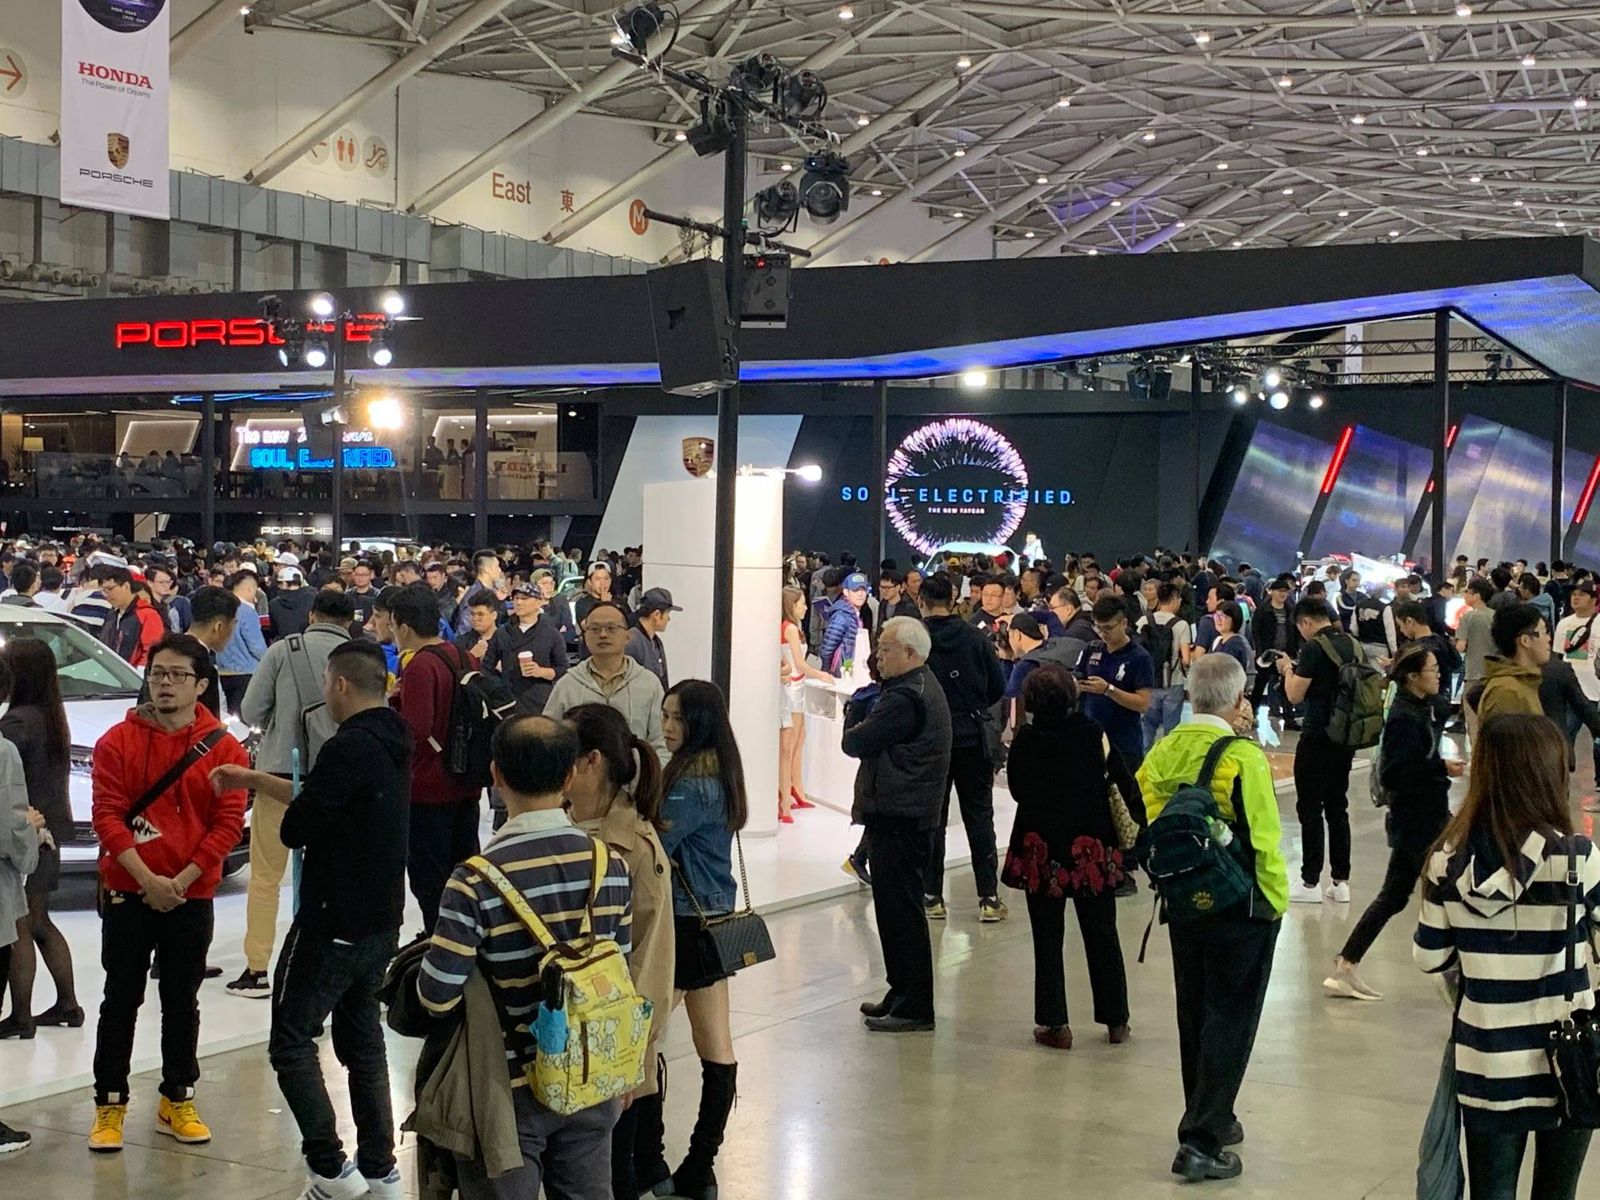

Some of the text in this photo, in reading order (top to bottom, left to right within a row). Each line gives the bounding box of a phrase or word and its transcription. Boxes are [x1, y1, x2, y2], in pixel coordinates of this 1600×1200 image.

[78, 61, 153, 90] HONDA
[95, 80, 117, 91] Power
[79, 168, 154, 188] PORSCHE
[492, 172, 575, 213] East 東
[299, 447, 396, 469] ERIFIED.
[260, 526, 333, 536] PORSCHE
